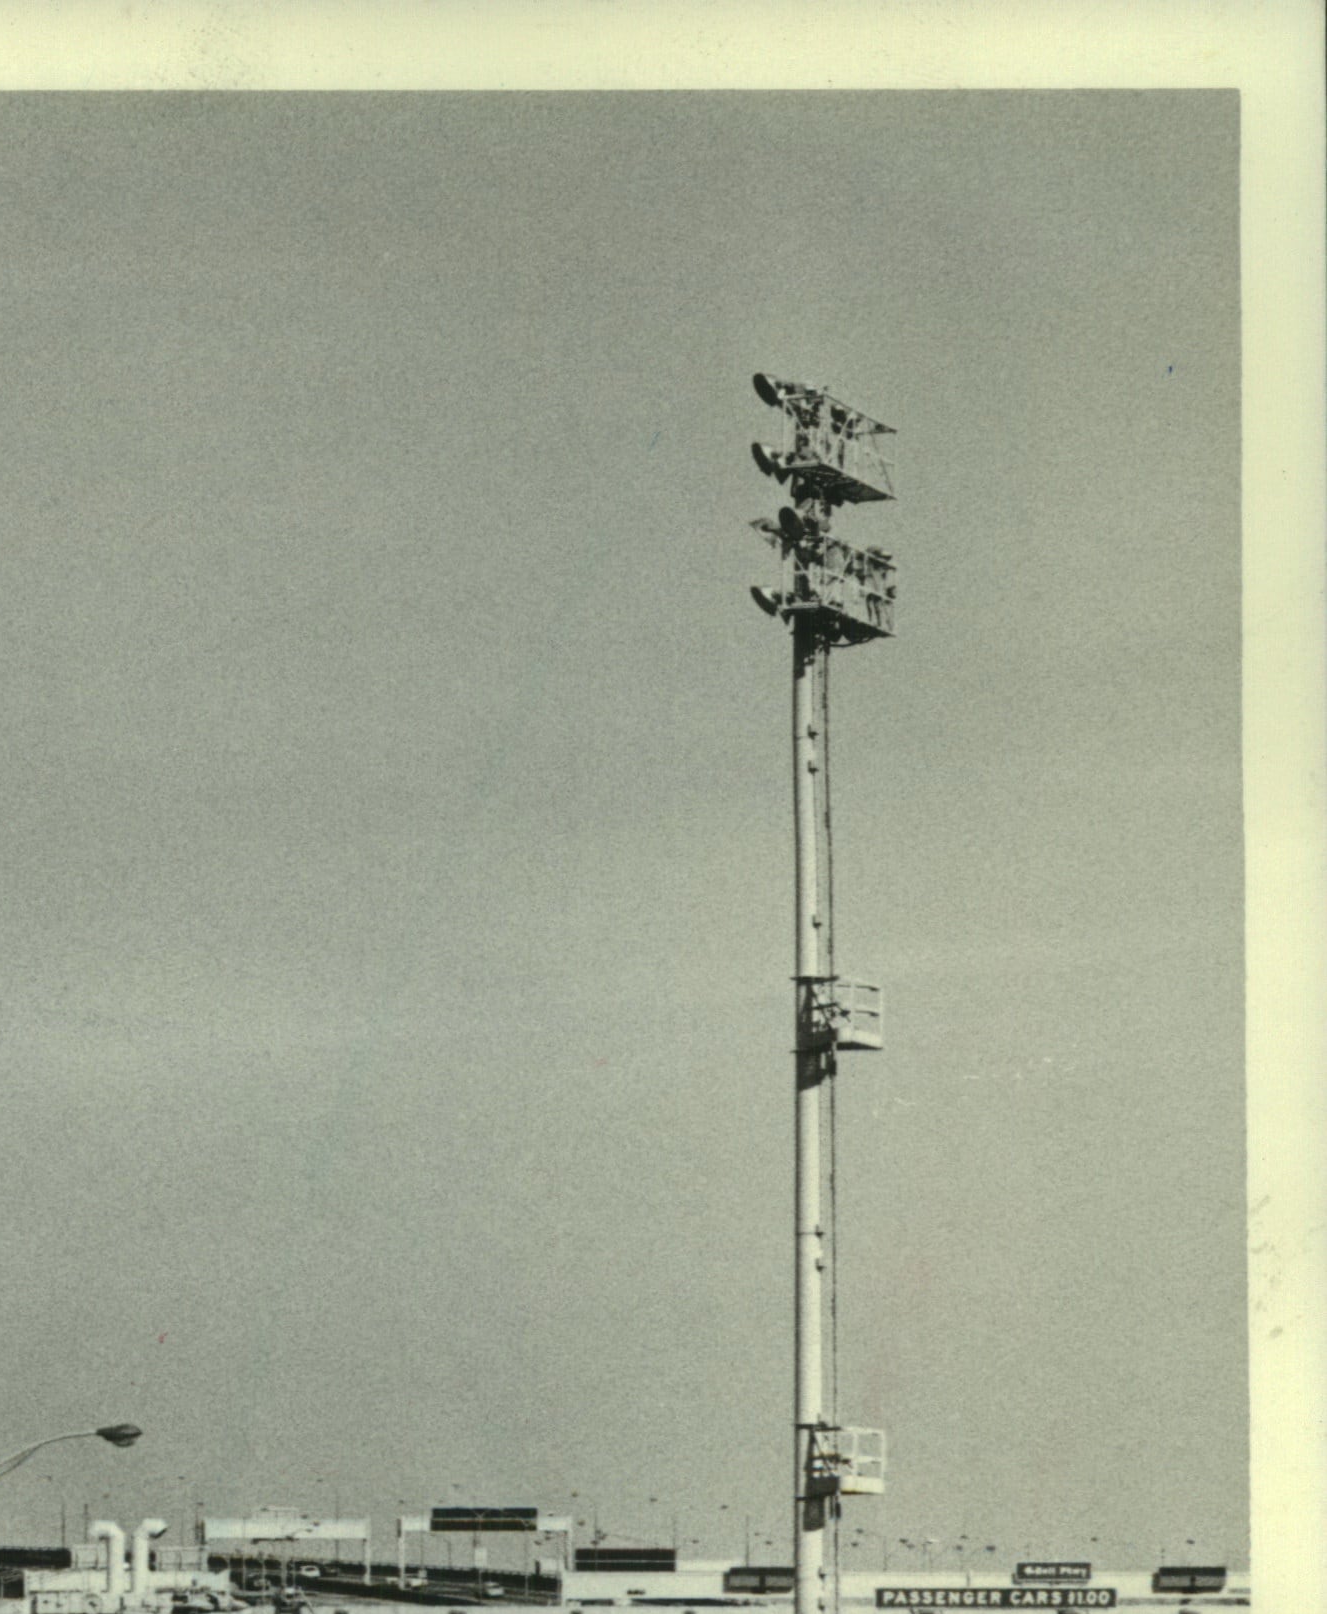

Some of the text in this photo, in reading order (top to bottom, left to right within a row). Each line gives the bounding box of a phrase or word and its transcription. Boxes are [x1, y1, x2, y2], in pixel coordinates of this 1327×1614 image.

[882, 1591, 1111, 1604] PASSENGER CARS $1.00
